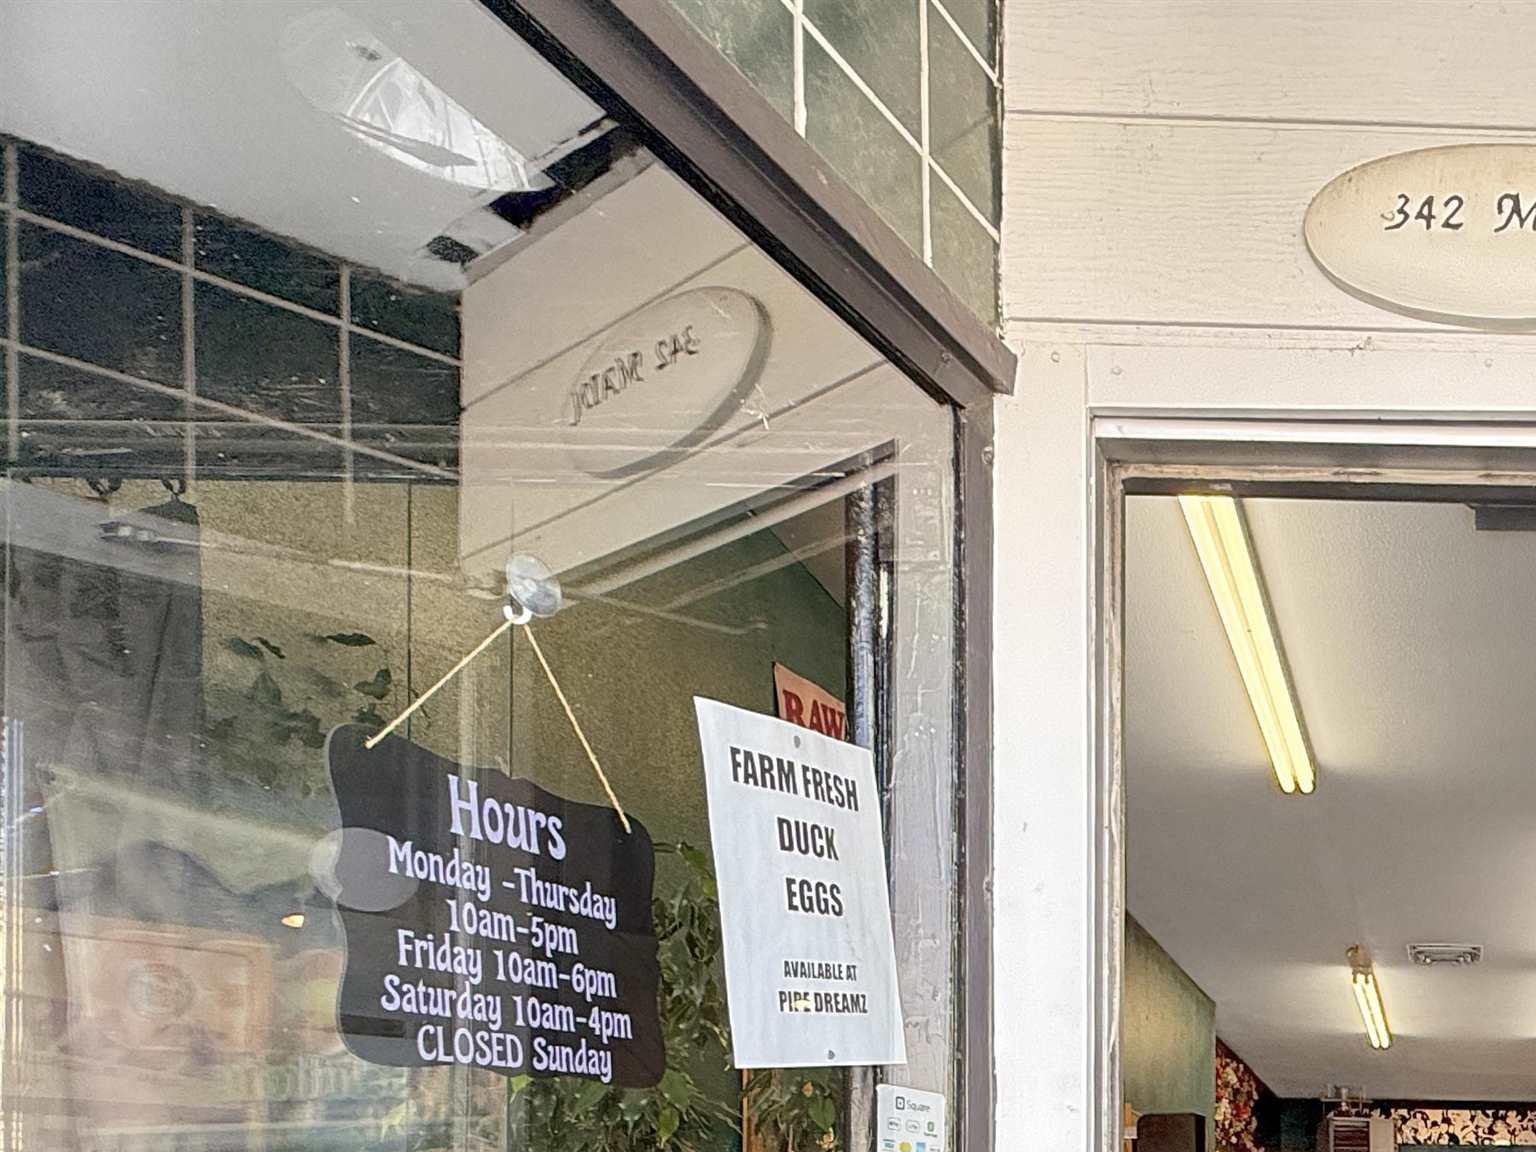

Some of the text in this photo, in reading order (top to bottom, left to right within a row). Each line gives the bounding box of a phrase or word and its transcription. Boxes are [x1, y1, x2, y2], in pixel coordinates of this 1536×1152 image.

[1384, 194, 1464, 231] 342
[782, 689, 846, 741] RAW
[730, 746, 859, 812] FARM FRESH
[448, 774, 567, 861] Hours
[777, 817, 839, 860] DUCK
[386, 834, 491, 901] Monday
[785, 877, 844, 917] EGGS
[446, 899, 579, 958] 10am-5pm
[397, 928, 618, 1002] Friday 10am-6pm
[784, 960, 857, 981] AVAILABLE AT
[380, 974, 633, 1044] Saturday 10am-4pm
[778, 991, 868, 1013] PIPE DREAMZ
[417, 1024, 612, 1084] CLOSED Sunday
